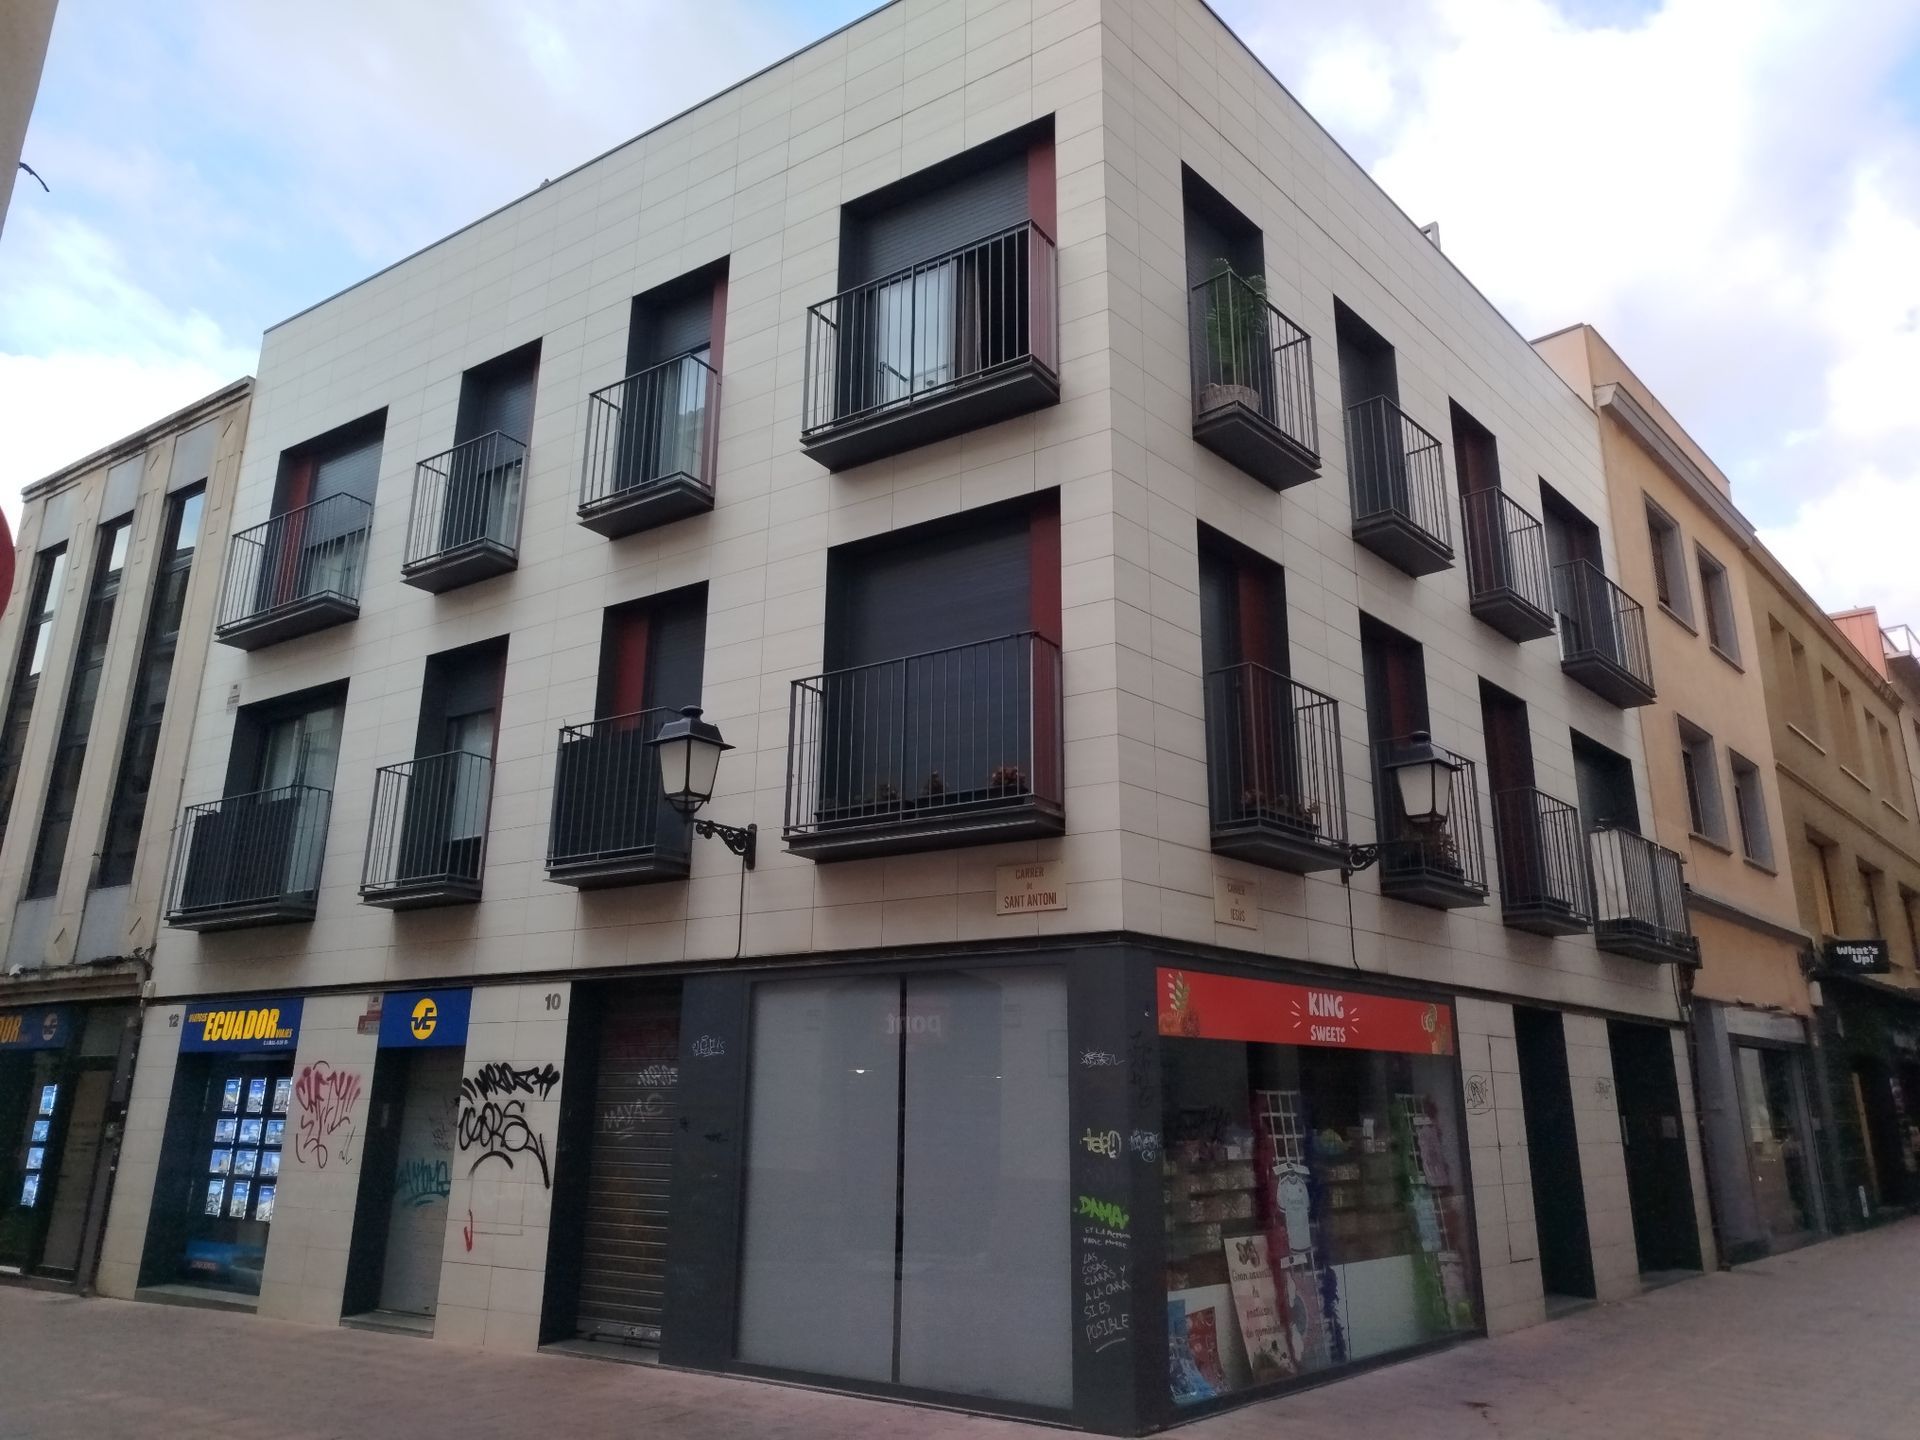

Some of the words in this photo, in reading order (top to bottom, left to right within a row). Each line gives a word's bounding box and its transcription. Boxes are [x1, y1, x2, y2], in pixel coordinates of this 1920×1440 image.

[1016, 867, 1044, 880] CARRER
[1005, 895, 1025, 909] SANT
[1027, 892, 1057, 906] ANTONI
[1836, 945, 1879, 955] What's
[1852, 954, 1875, 965] Up!
[545, 992, 562, 1011] 10
[1308, 991, 1345, 1019] KING
[168, 1014, 180, 1028] 12
[203, 1008, 280, 1041] ECUADOR
[1310, 1024, 1346, 1043] SWEETS
[1083, 1252, 1098, 1265] LAS
[1081, 1260, 1108, 1275] COSAS
[1086, 1313, 1130, 1345] POSIBLE
